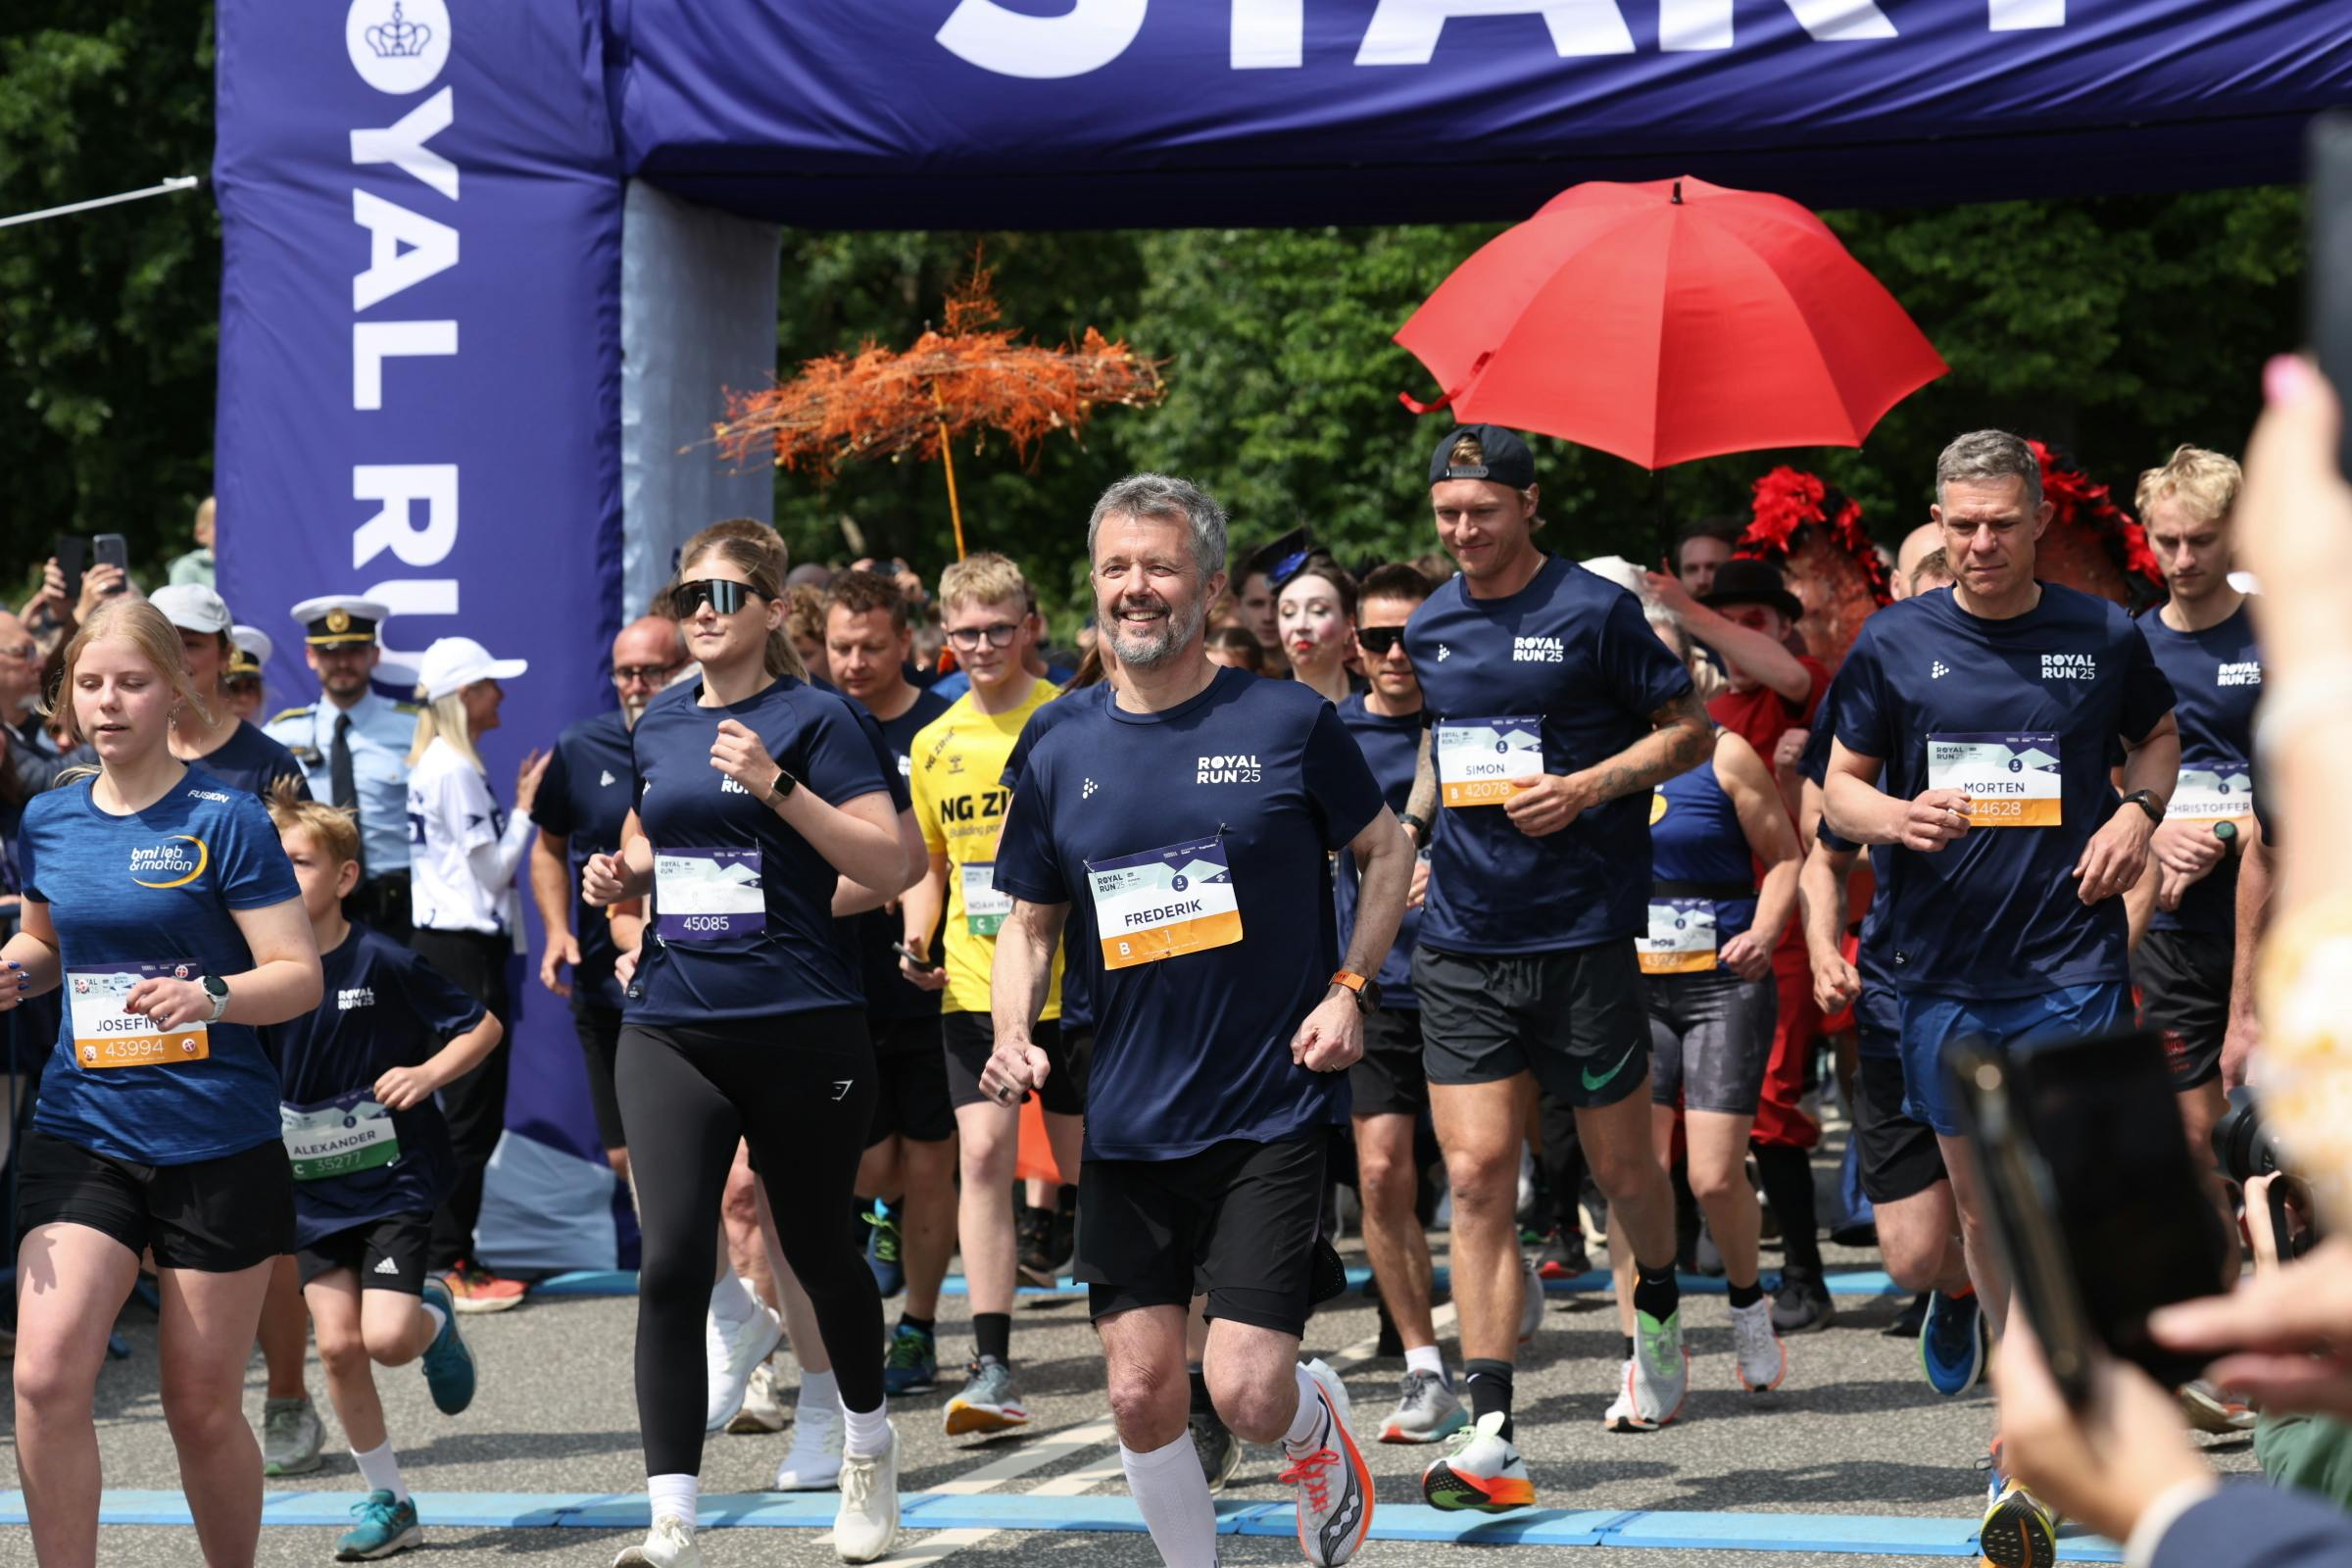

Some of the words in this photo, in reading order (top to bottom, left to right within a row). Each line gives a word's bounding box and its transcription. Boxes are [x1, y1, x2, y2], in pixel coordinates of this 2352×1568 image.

[1514, 636, 1564, 650] ROYAL
[2040, 654, 2096, 666] ROYAL
[2219, 662, 2261, 674] ROYAL
[1198, 755, 1262, 770] ROYAL
[1465, 763, 1505, 776] SIMON
[721, 779, 750, 795] RU
[1465, 781, 1510, 798] 42078
[1964, 782, 2026, 794] MORTEN
[187, 788, 230, 804] FUSION
[941, 795, 974, 824] NG
[982, 790, 1012, 817] ZI
[1969, 801, 2023, 816] 44628
[2167, 803, 2251, 814] CHRISTOFFER
[130, 845, 161, 860] bmi
[128, 858, 193, 871] &motion
[1097, 873, 1124, 886] ROYAL
[1176, 877, 1183, 886] 5
[968, 901, 995, 910] NOAH
[1124, 899, 1203, 927] FREDERIK
[683, 915, 730, 931] 45085
[976, 917, 986, 930] C
[1118, 942, 1131, 956] B
[337, 986, 374, 1001] ROYAL
[96, 1014, 169, 1032] JOSEFI
[105, 1037, 166, 1057] 43994
[294, 1130, 376, 1155] ALEXANDER
[294, 1163, 305, 1175] C
[315, 1152, 362, 1172] 35277
